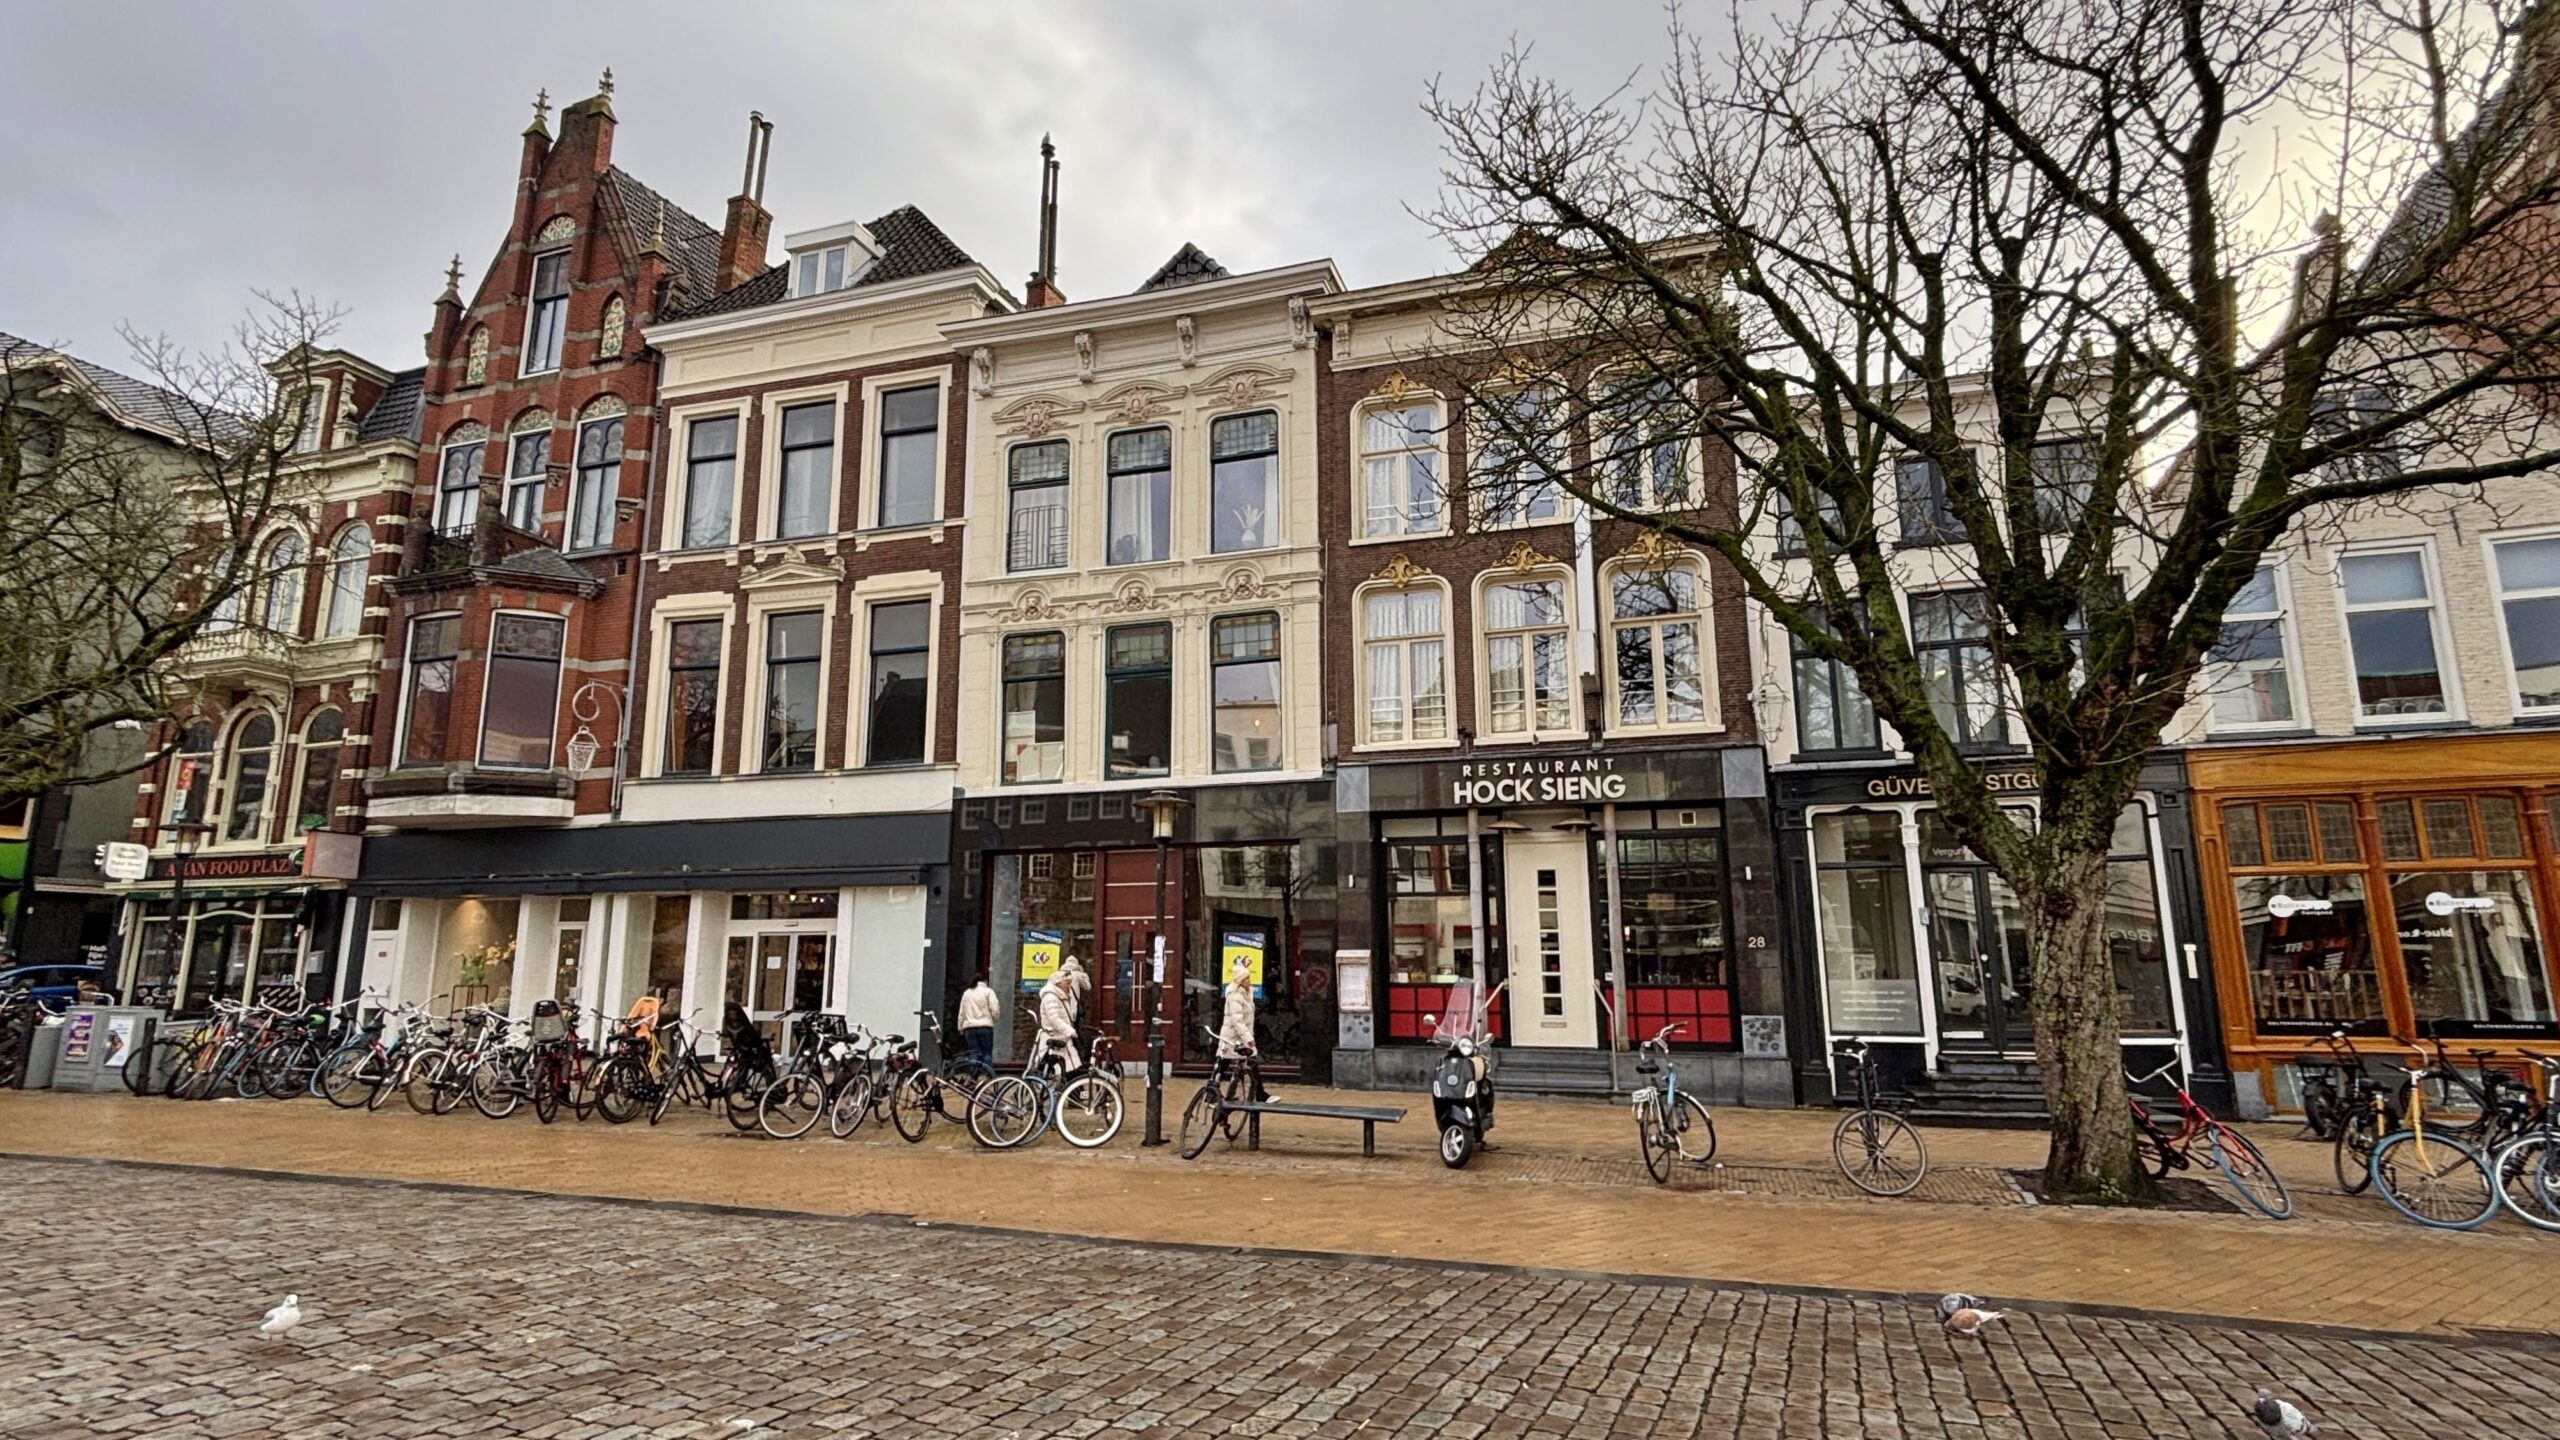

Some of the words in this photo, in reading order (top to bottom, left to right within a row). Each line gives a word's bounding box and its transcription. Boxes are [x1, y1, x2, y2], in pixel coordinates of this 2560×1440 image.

[1462, 758, 1615, 777] RESTAURANT
[1453, 778, 1534, 804] HOCK
[1541, 774, 1626, 801] SIENG
[1867, 776, 1931, 796] GÜVE
[166, 860, 208, 877] AIAN
[210, 859, 249, 875] FOOD
[251, 858, 290, 874] PLAZ
[1748, 936, 1766, 948] 28
